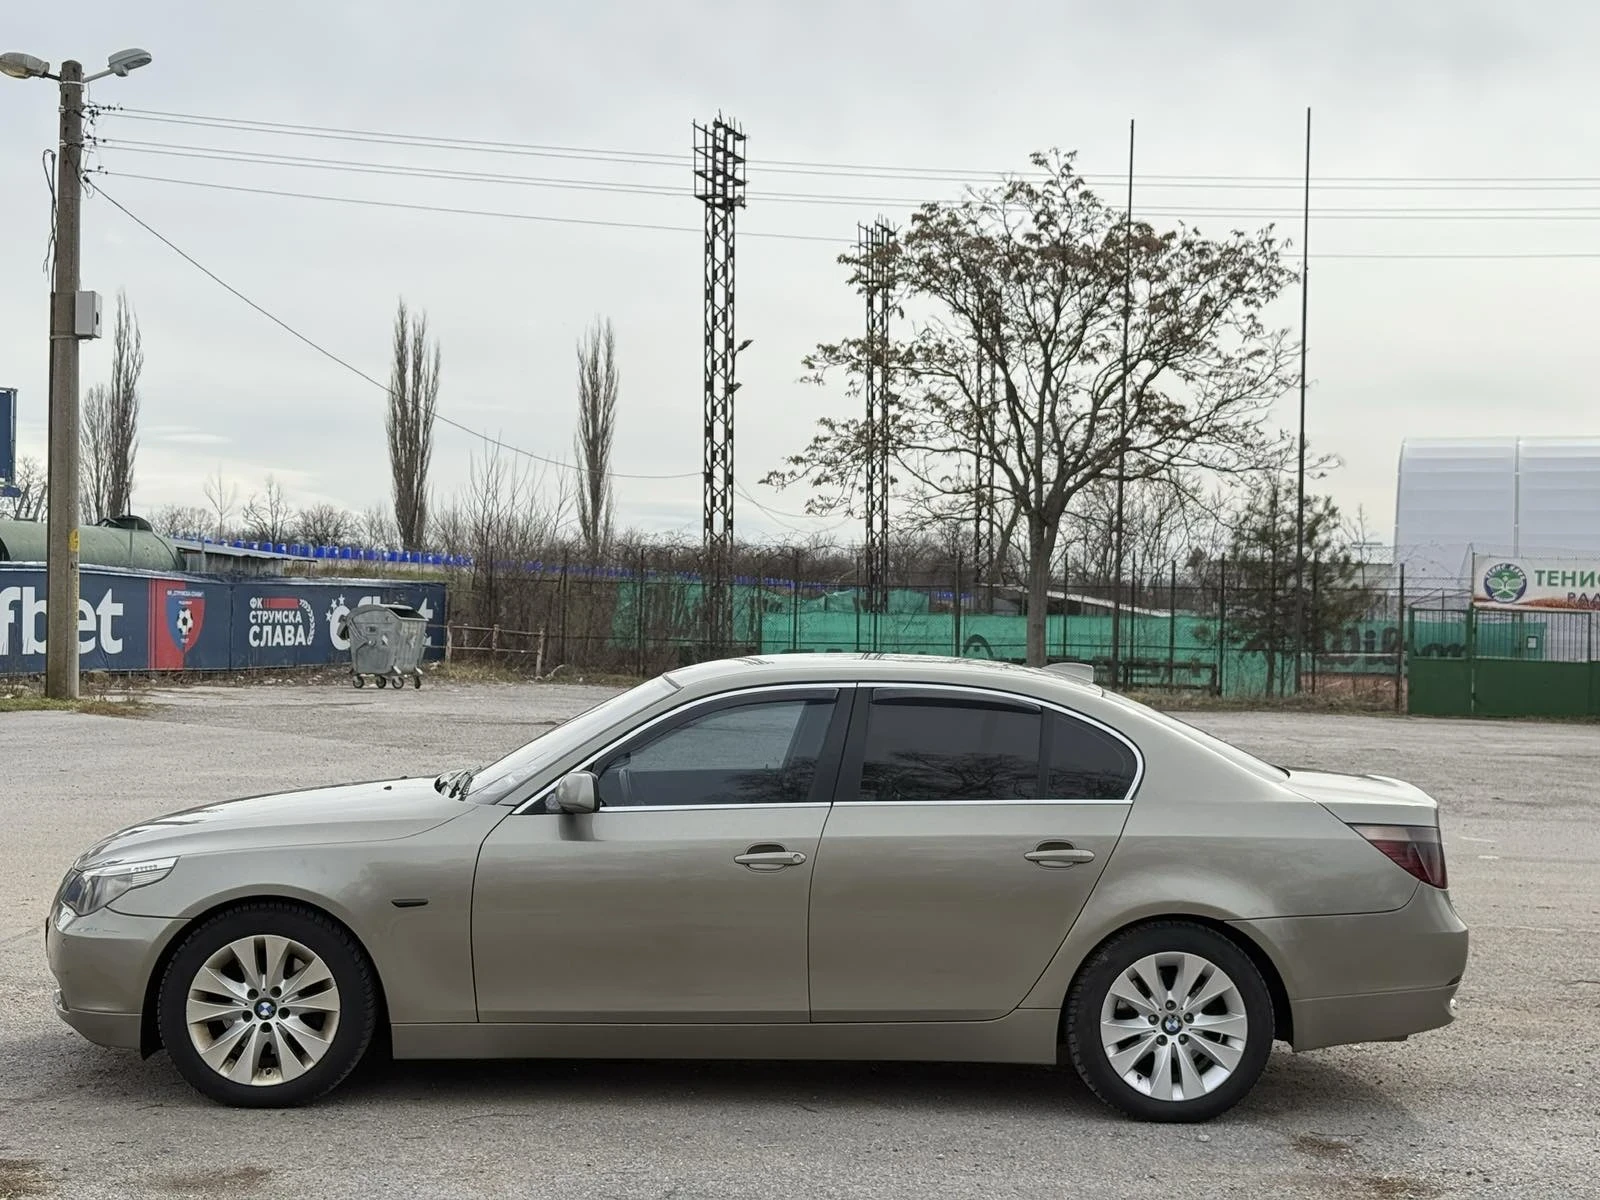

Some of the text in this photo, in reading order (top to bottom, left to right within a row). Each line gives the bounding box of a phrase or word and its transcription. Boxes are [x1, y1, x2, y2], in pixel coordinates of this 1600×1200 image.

[1534, 569, 1600, 588] ТЕНИ
[249, 596, 263, 609] ФК
[249, 610, 303, 624] СТРУМСКА
[248, 624, 306, 647] СЛАВА
